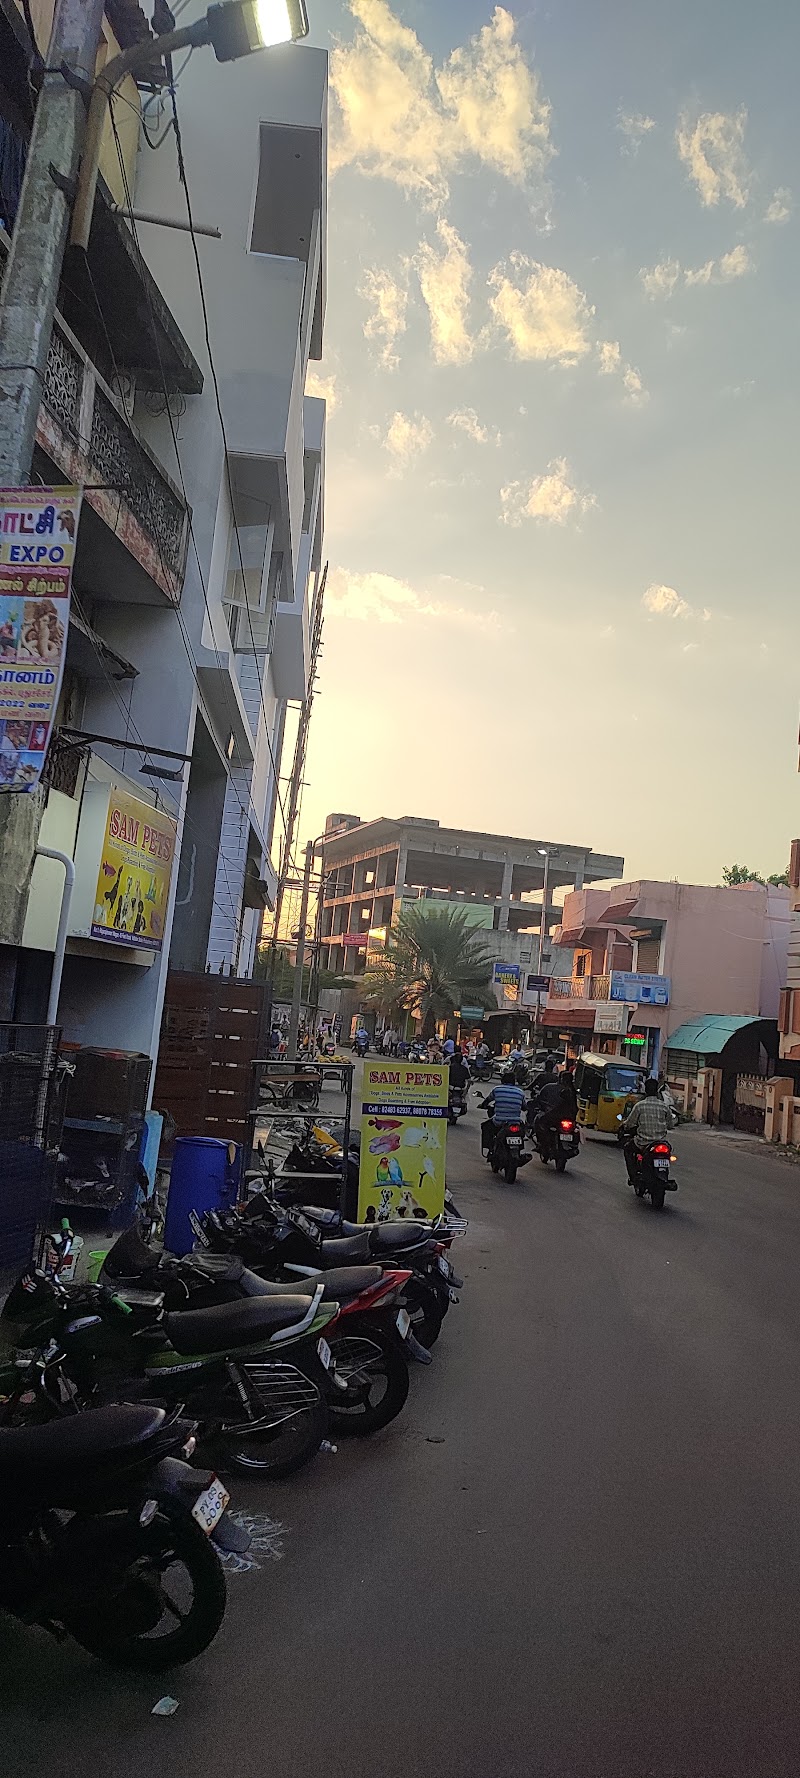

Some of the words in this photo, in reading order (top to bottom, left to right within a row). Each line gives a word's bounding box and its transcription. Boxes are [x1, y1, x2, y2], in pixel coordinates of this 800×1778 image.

[0, 506, 54, 534] ாட்சி
[10, 545, 64, 562] EXPO
[109, 808, 138, 845] SAM
[141, 824, 171, 860] PETS
[370, 1071, 401, 1085] SAM
[405, 1073, 442, 1087] PETS
